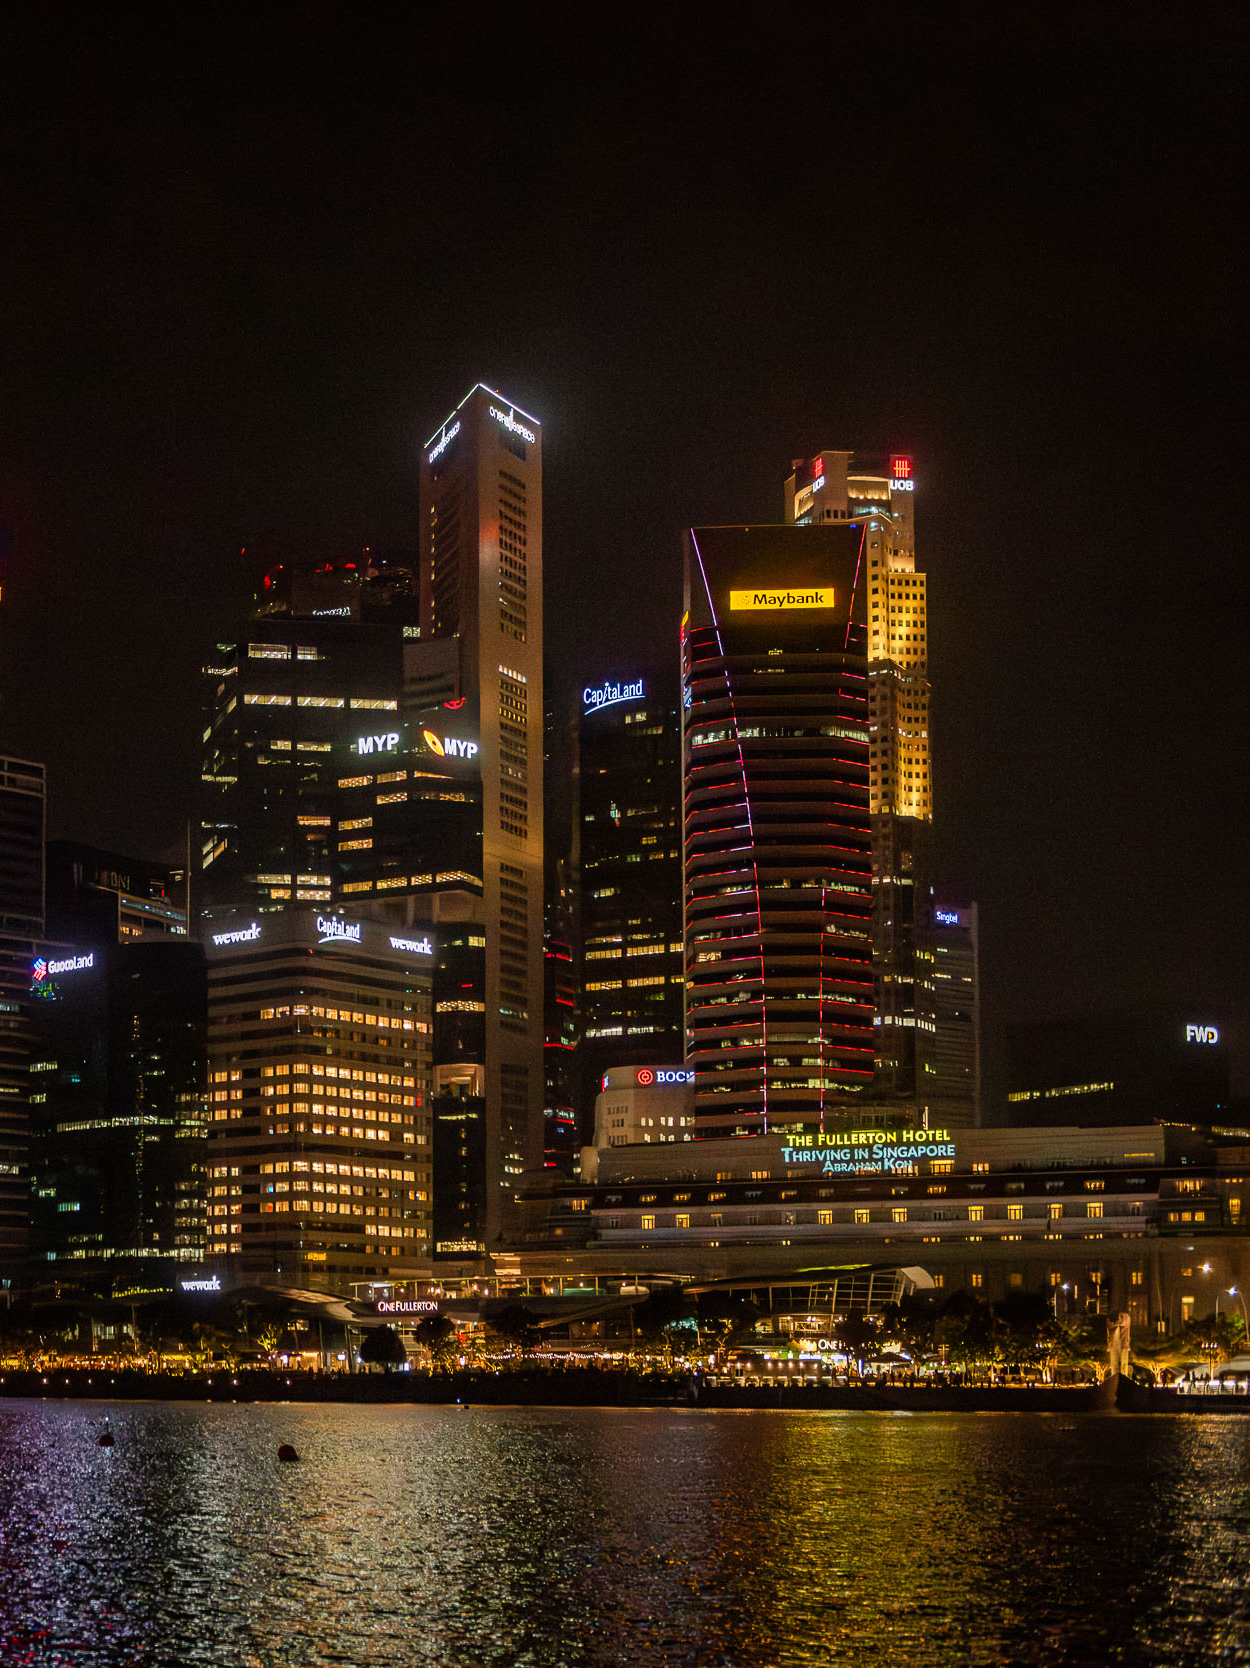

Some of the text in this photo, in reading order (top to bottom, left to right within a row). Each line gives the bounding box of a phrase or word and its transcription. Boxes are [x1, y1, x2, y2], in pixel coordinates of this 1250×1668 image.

[890, 480, 914, 491] UOB
[753, 591, 824, 607] Maybank
[583, 679, 643, 706] CapitaLand
[358, 733, 400, 754] MYP
[444, 738, 478, 758] MYP
[316, 915, 361, 939] CapitaLand
[936, 911, 958, 924] Singtel
[212, 922, 262, 945] wework
[389, 936, 433, 954] wework
[48, 952, 93, 974] GuocoLand
[1186, 1025, 1219, 1044] FWD
[786, 1129, 950, 1147] THE FULLERTON HOTEL
[781, 1144, 956, 1163] THRIVING IN SINGAPORE
[822, 1160, 882, 1173] ABRAHAM
[818, 1339, 837, 1350] ONE
